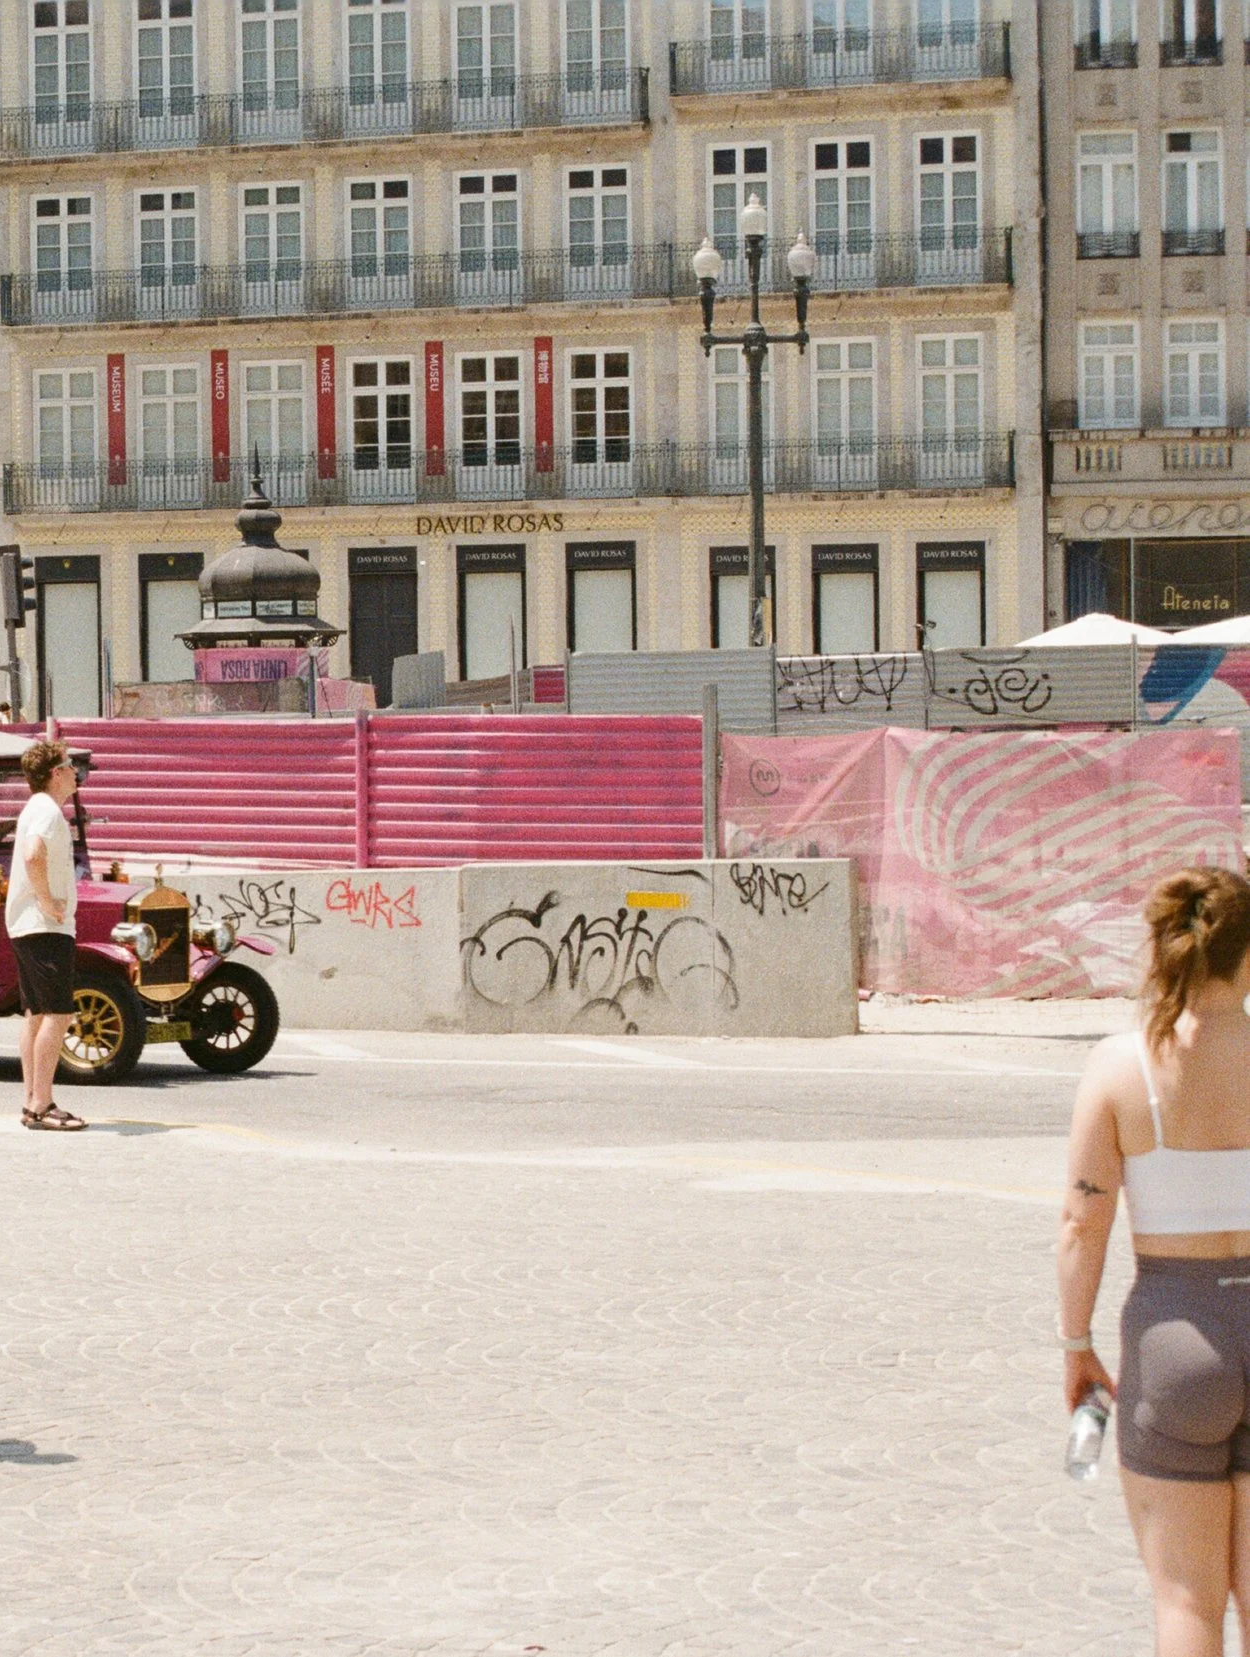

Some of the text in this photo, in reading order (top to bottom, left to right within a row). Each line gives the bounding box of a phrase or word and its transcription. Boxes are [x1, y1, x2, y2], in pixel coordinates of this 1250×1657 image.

[215, 362, 225, 400] MUSEO
[320, 357, 331, 394] MUSÉE
[429, 353, 439, 392] MUSEU
[111, 366, 121, 413] MUSEUM
[416, 513, 565, 536] DAVID ROSAS
[356, 554, 408, 564] DAVID ROSAS
[465, 551, 516, 561] DAVID ROSAS
[574, 548, 627, 558] DAVID ROSAS
[716, 554, 742, 563] DAVID
[818, 551, 872, 561] DAVID ROSAS
[923, 549, 978, 558] DAVID ROSAS
[1161, 585, 1231, 610] Ateneia
[220, 658, 251, 680] ROSA
[253, 658, 288, 680] LINHA
